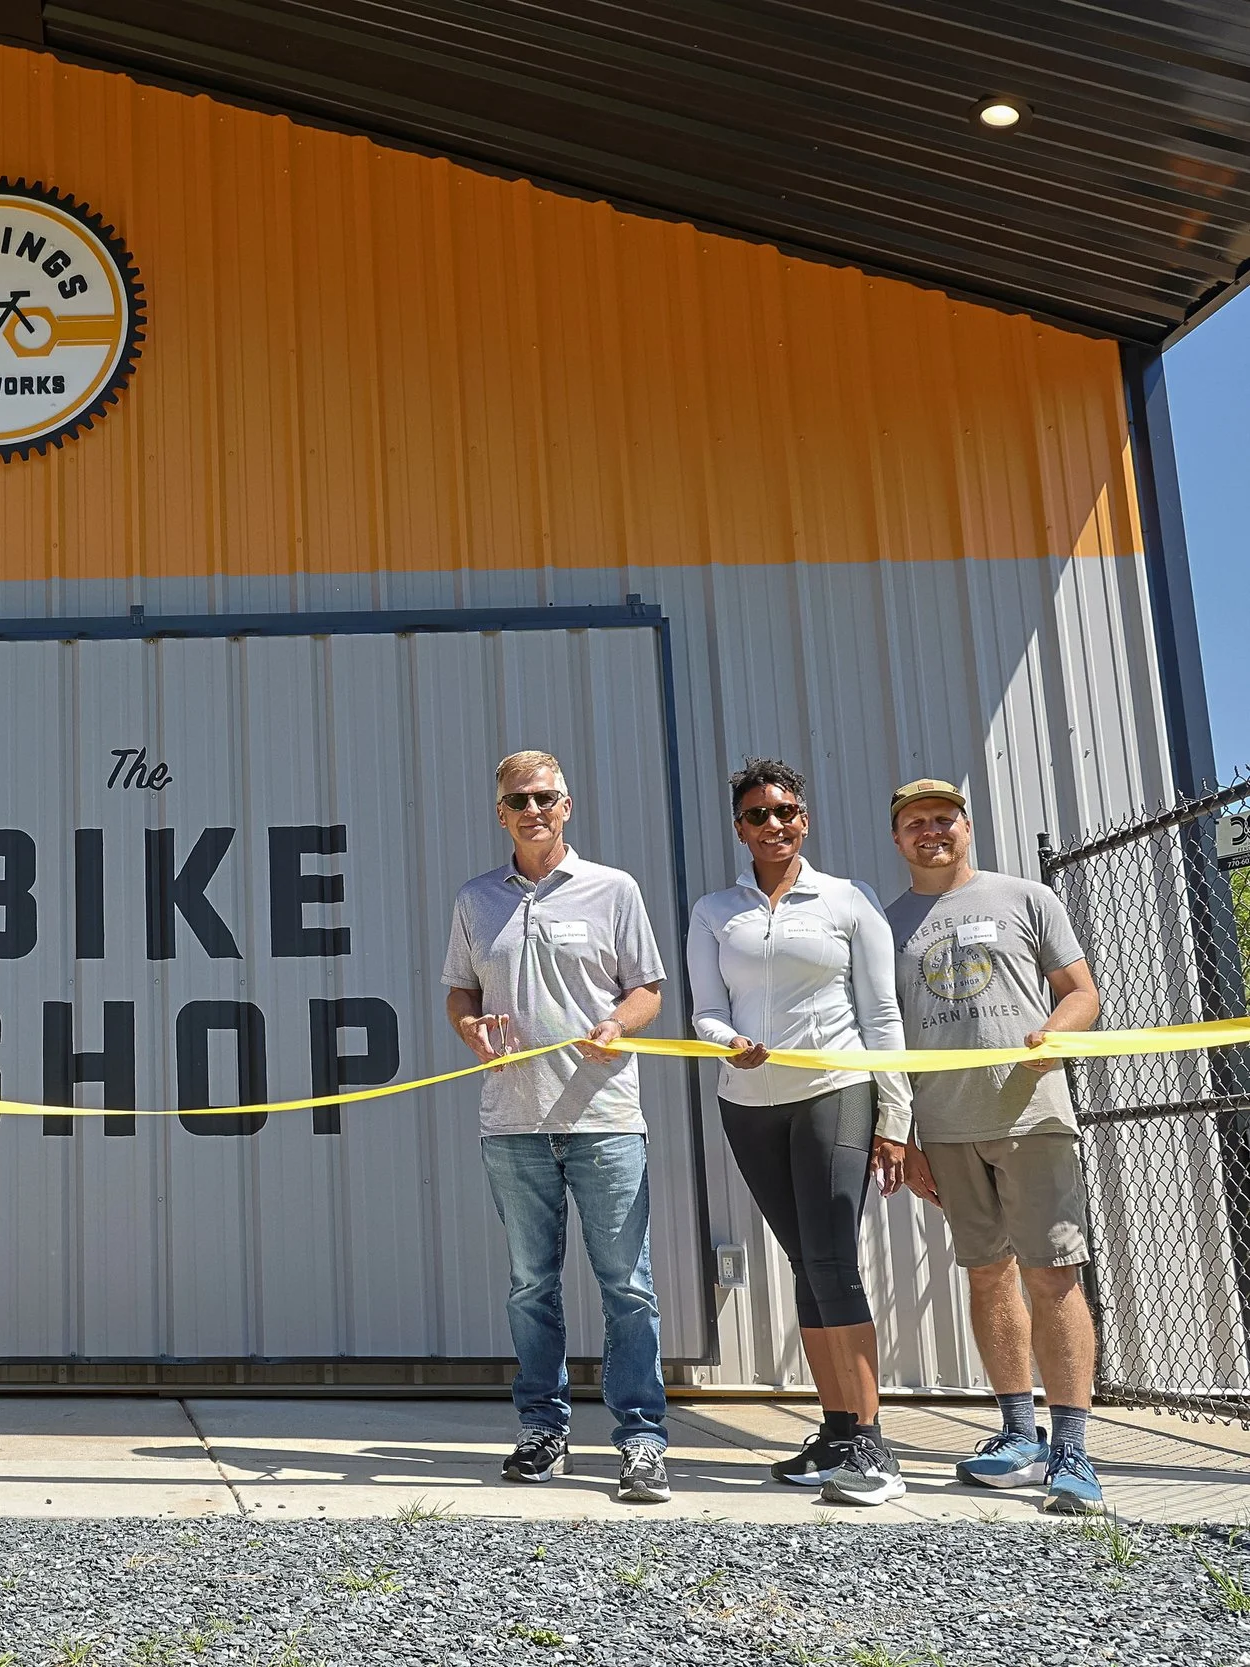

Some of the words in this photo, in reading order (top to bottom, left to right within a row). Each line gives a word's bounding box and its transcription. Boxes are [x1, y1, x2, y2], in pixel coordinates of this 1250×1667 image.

[107, 746, 173, 791] The
[897, 917, 954, 954] WHERE
[922, 1010, 962, 1030] EARN
[968, 1004, 1020, 1019] BIKES
